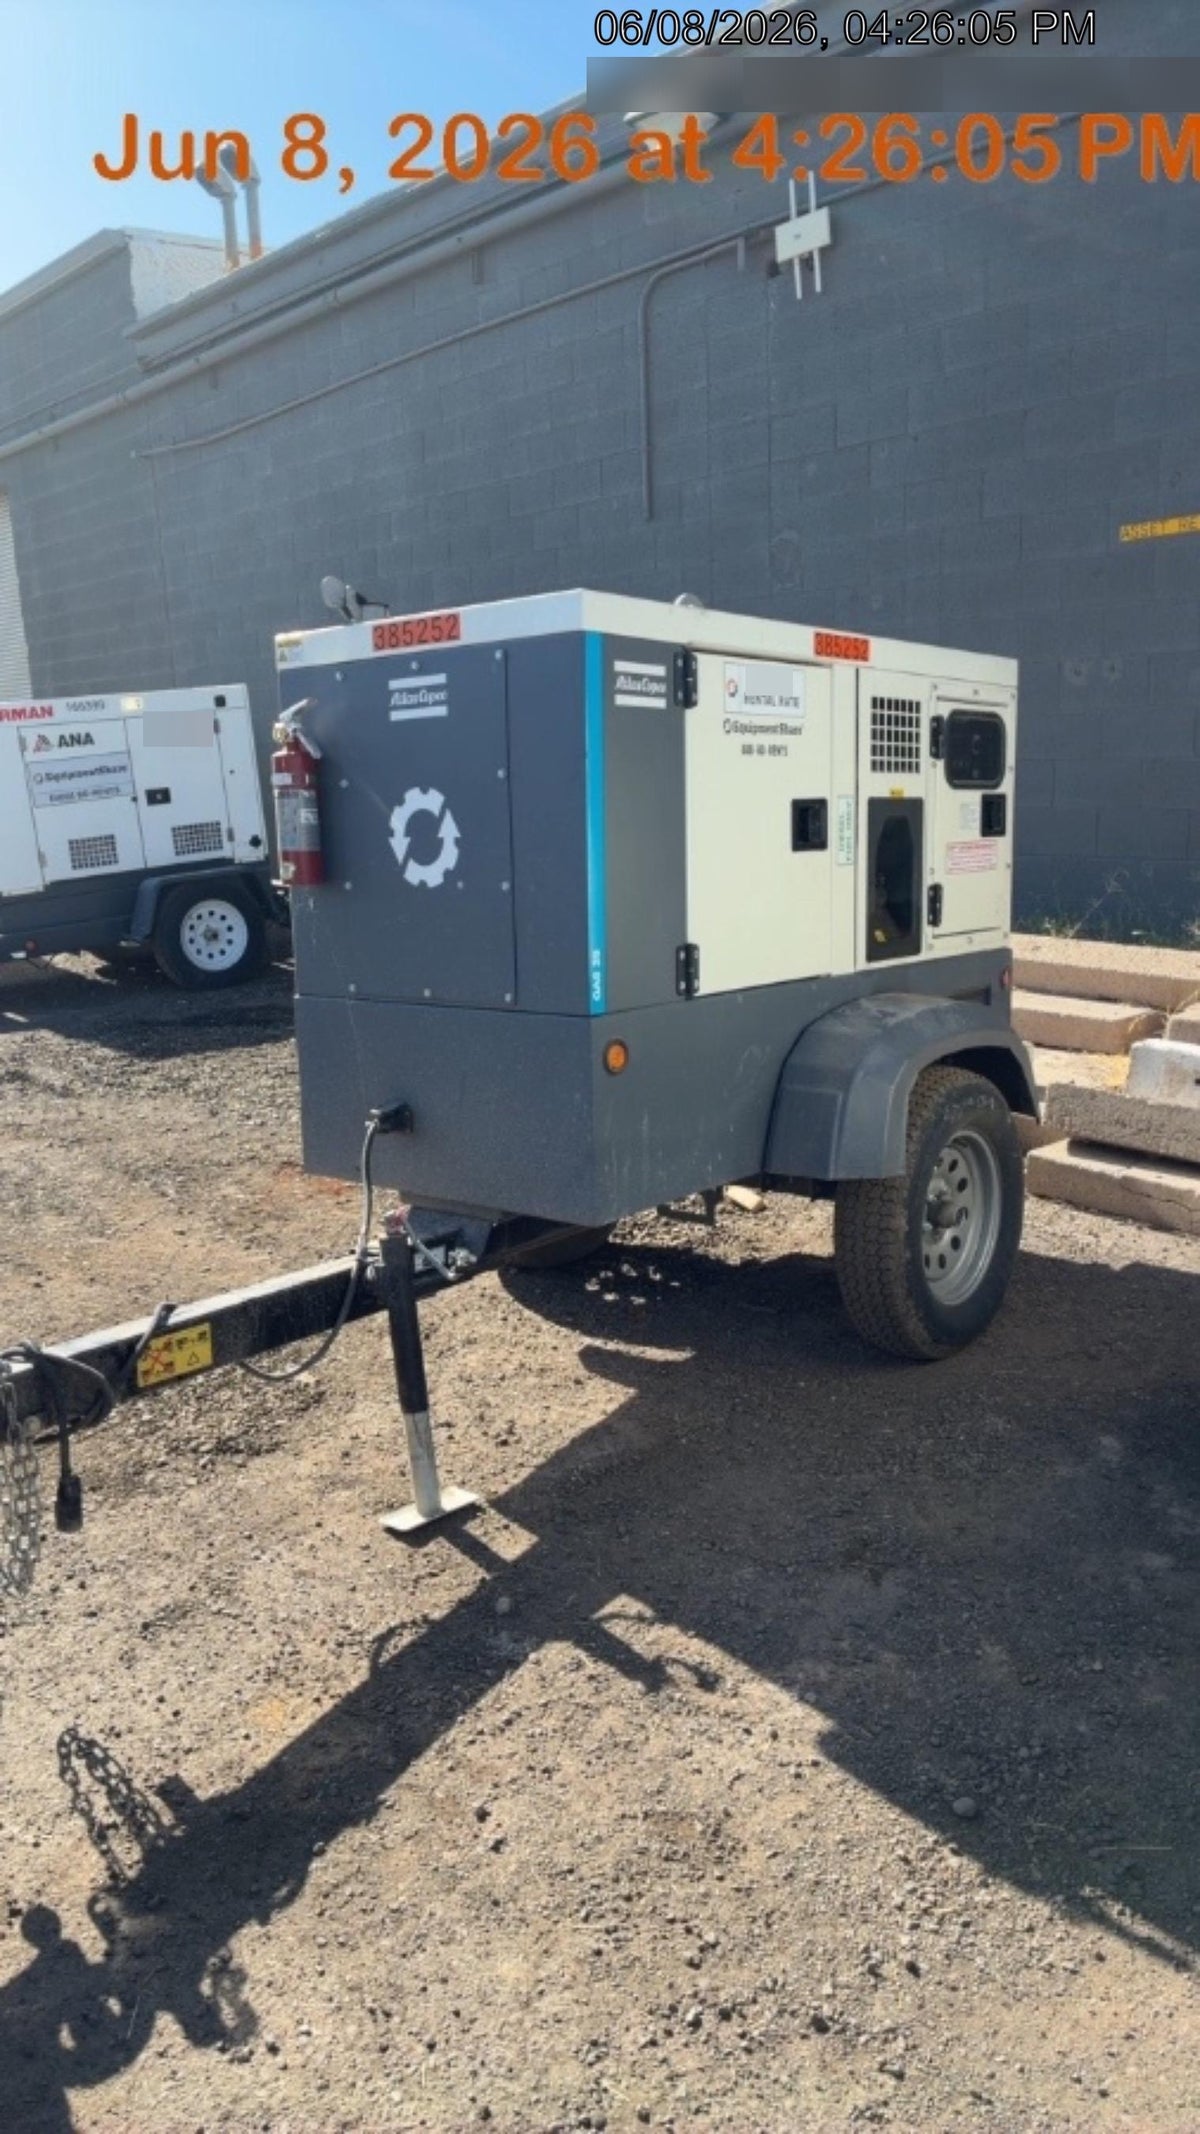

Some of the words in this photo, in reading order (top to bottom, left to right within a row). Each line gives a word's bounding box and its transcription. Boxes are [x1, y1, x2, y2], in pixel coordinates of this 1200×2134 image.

[374, 613, 459, 651] 385252
[815, 632, 869, 662] 385252
[57, 731, 95, 748] ANA
